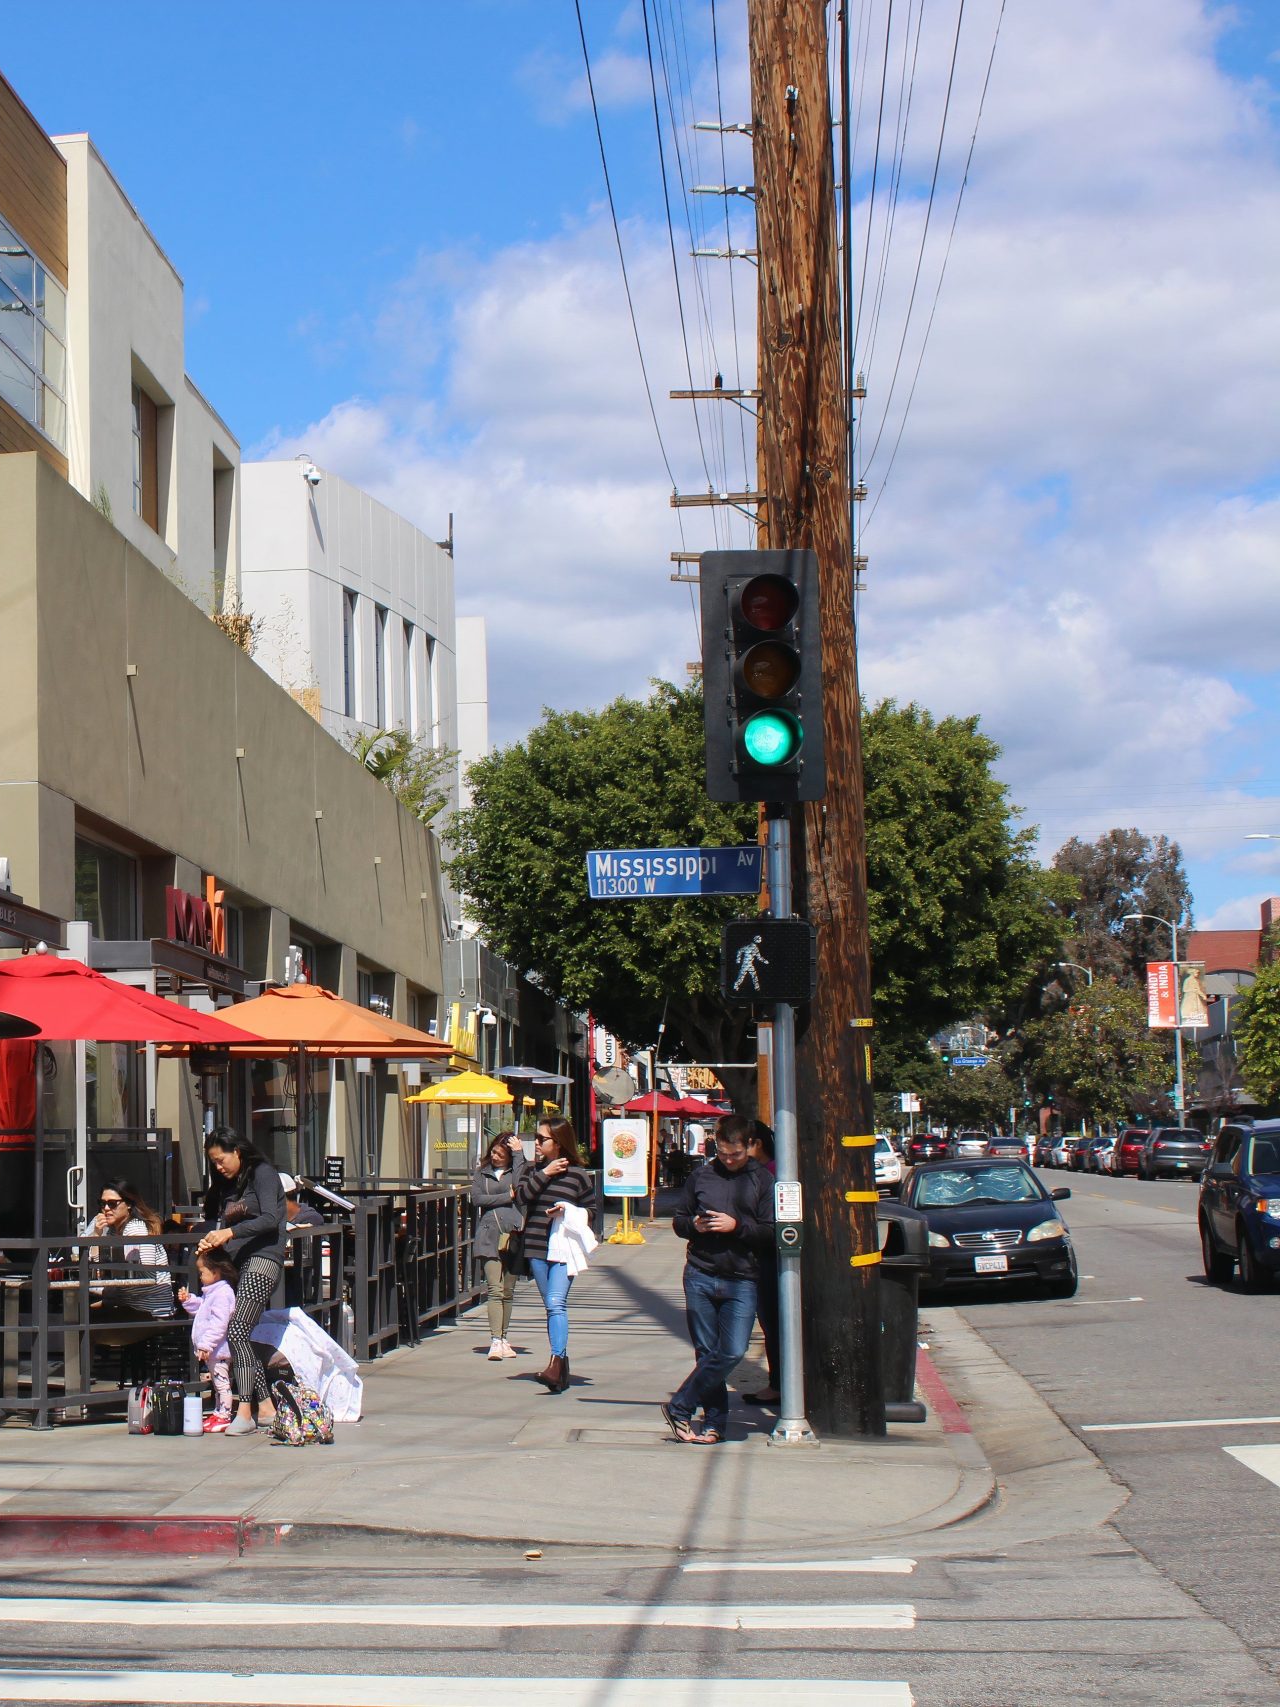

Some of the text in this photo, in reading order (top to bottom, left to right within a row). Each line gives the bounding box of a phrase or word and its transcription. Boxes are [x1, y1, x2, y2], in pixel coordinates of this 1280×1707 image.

[595, 850, 755, 881] Mississippi Av
[597, 877, 656, 895] 11300 W
[1158, 965, 1169, 989] INDIA
